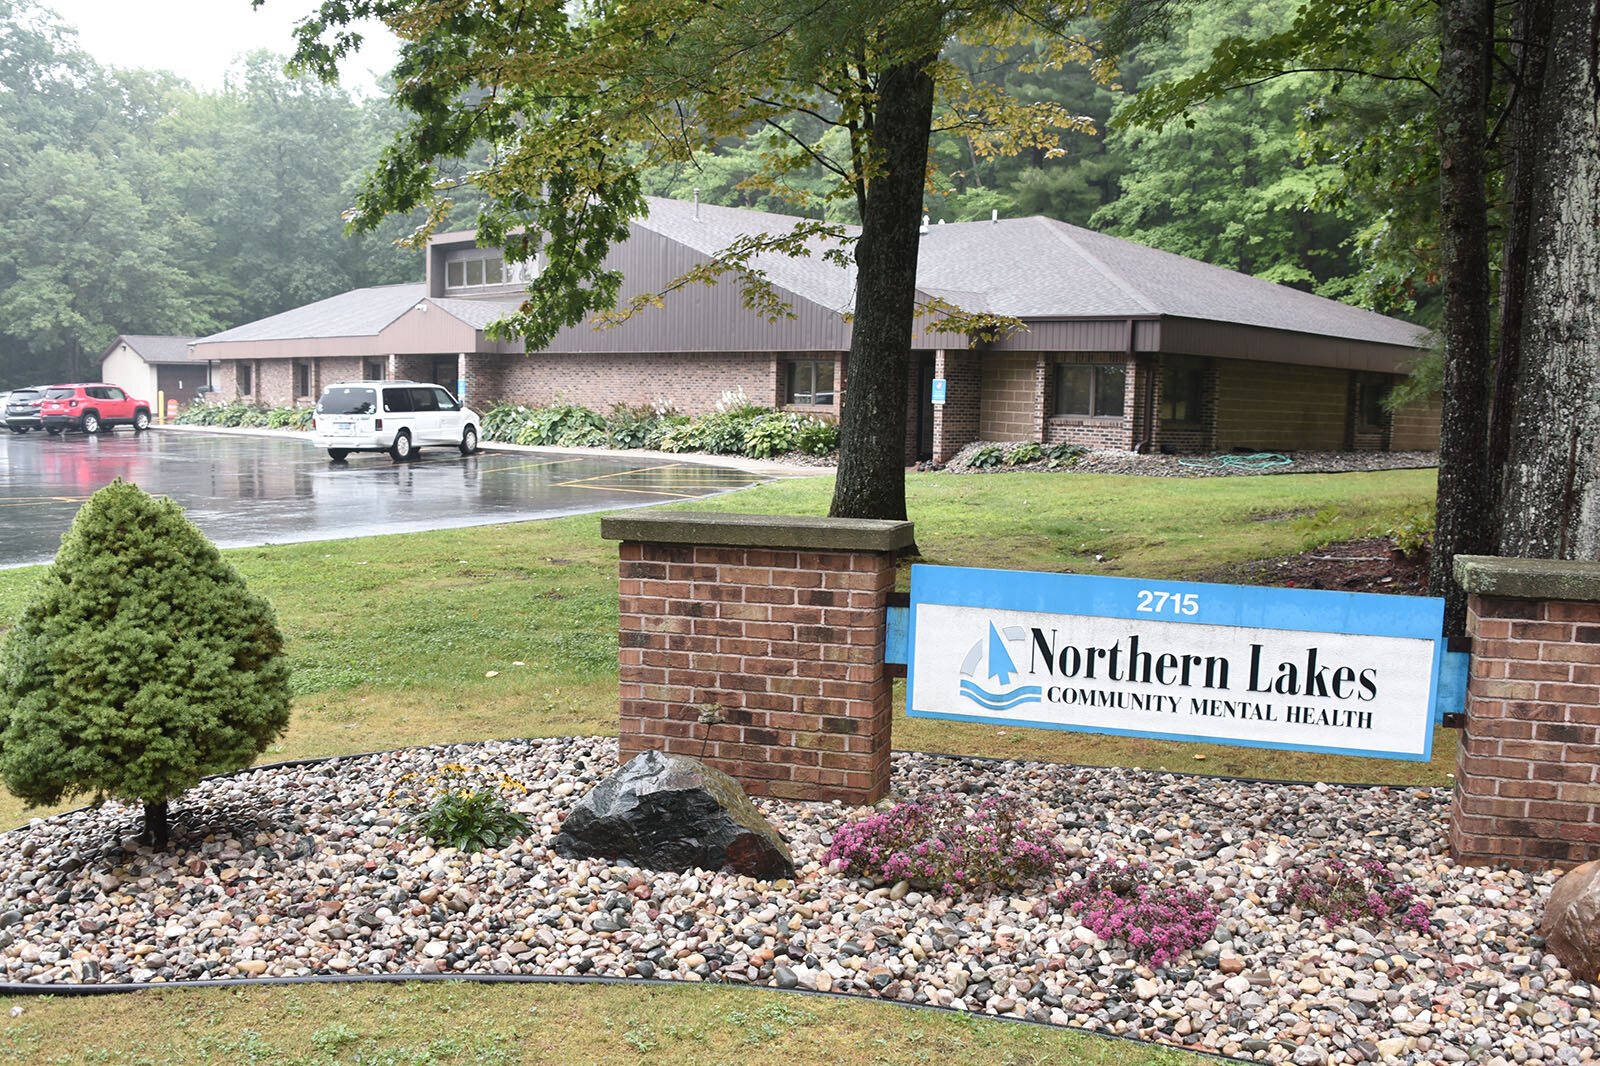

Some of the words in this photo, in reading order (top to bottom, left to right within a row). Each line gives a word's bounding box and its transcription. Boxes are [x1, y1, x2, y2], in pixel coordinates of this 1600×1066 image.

[1136, 590, 1200, 616] 2715
[1029, 627, 1230, 690] Northern
[1246, 643, 1378, 702] Lakes
[1046, 686, 1182, 713] COMMUNITY
[1189, 698, 1278, 722] MENTAL
[1285, 705, 1374, 729] HEALTH
